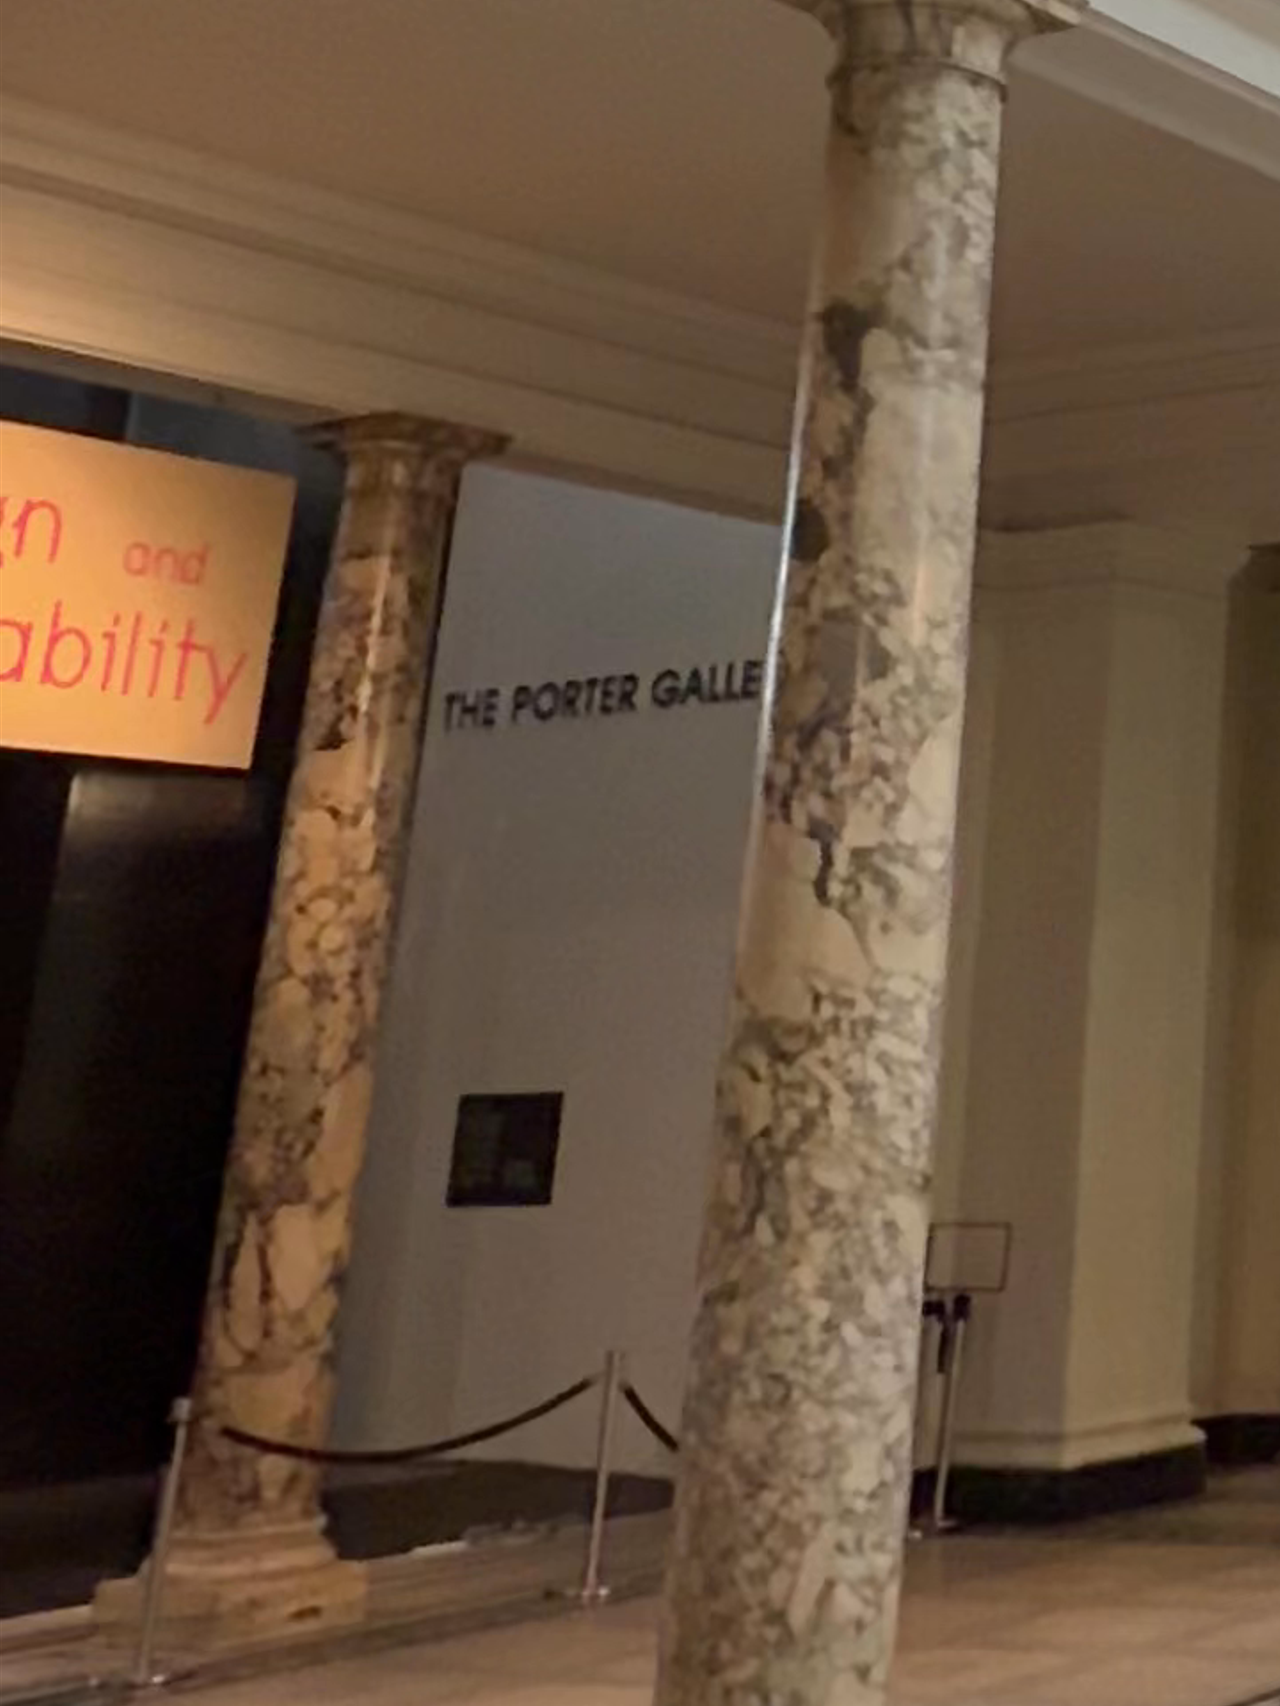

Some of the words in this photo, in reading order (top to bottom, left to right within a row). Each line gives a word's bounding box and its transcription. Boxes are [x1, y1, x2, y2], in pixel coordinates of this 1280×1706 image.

[0, 496, 62, 569] n
[123, 541, 212, 586] and
[0, 599, 248, 726] ability
[443, 688, 500, 731] THE
[512, 673, 640, 725] PORTER
